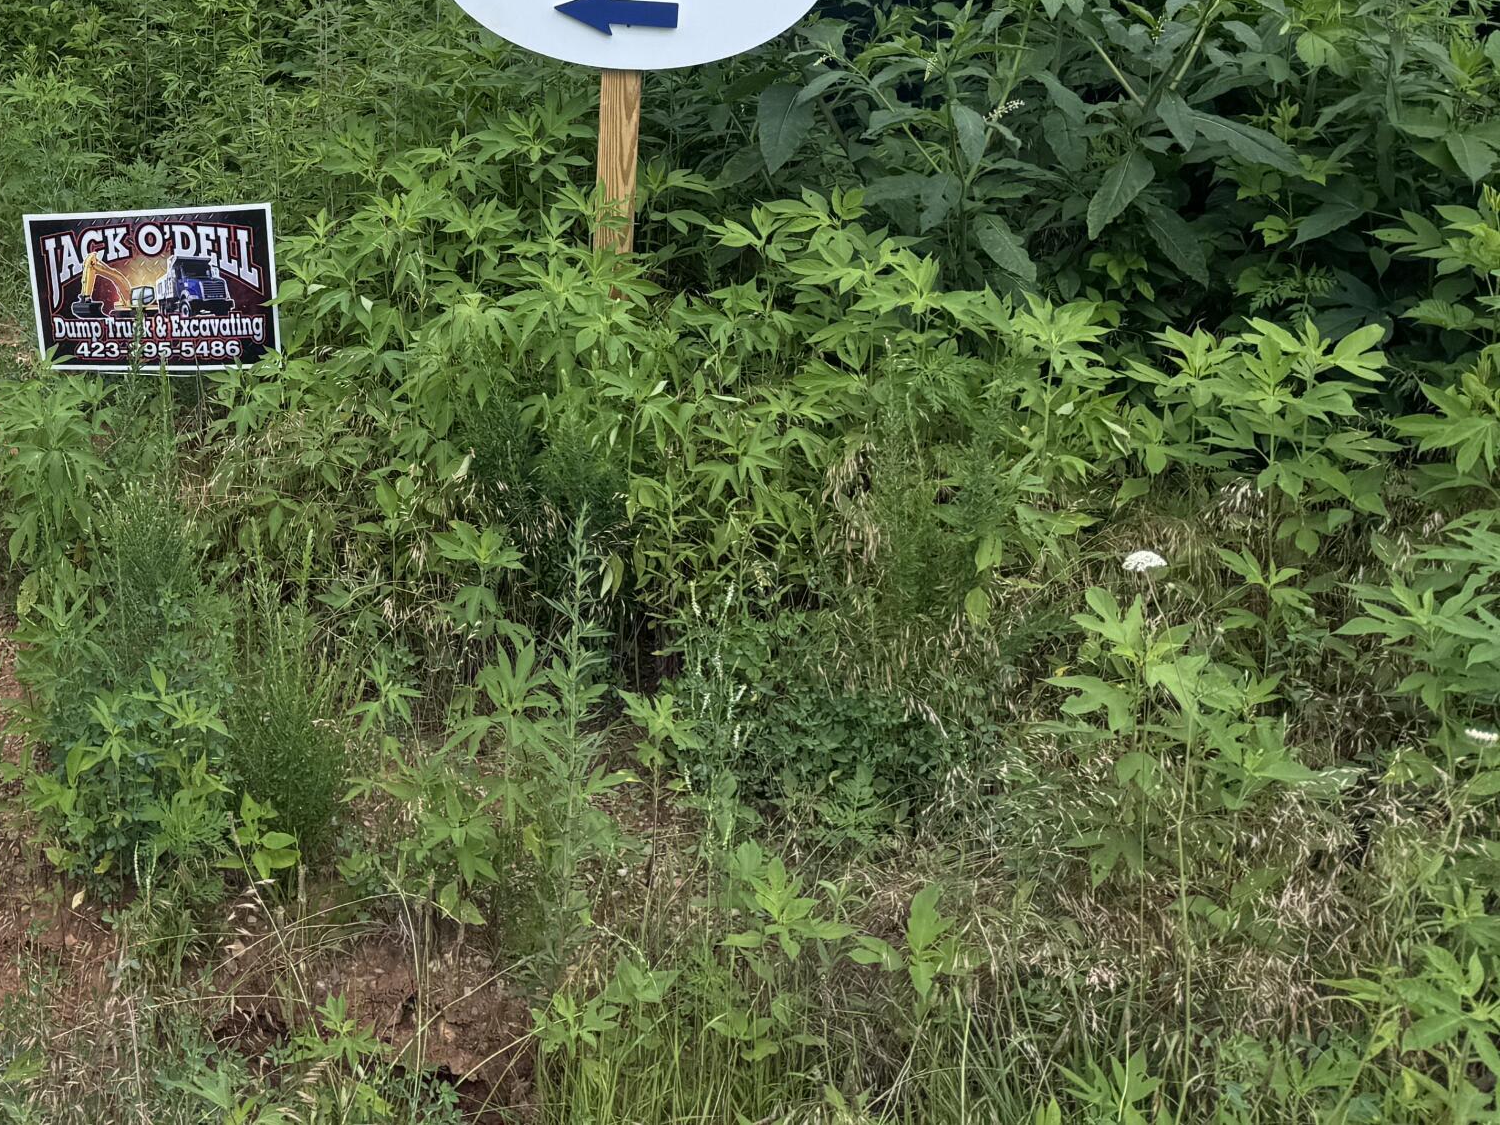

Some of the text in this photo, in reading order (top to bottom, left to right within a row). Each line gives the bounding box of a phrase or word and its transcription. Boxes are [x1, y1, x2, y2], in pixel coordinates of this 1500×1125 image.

[45, 224, 260, 308] JACK O'DELL
[54, 313, 264, 342] Dump Truk & Excavating
